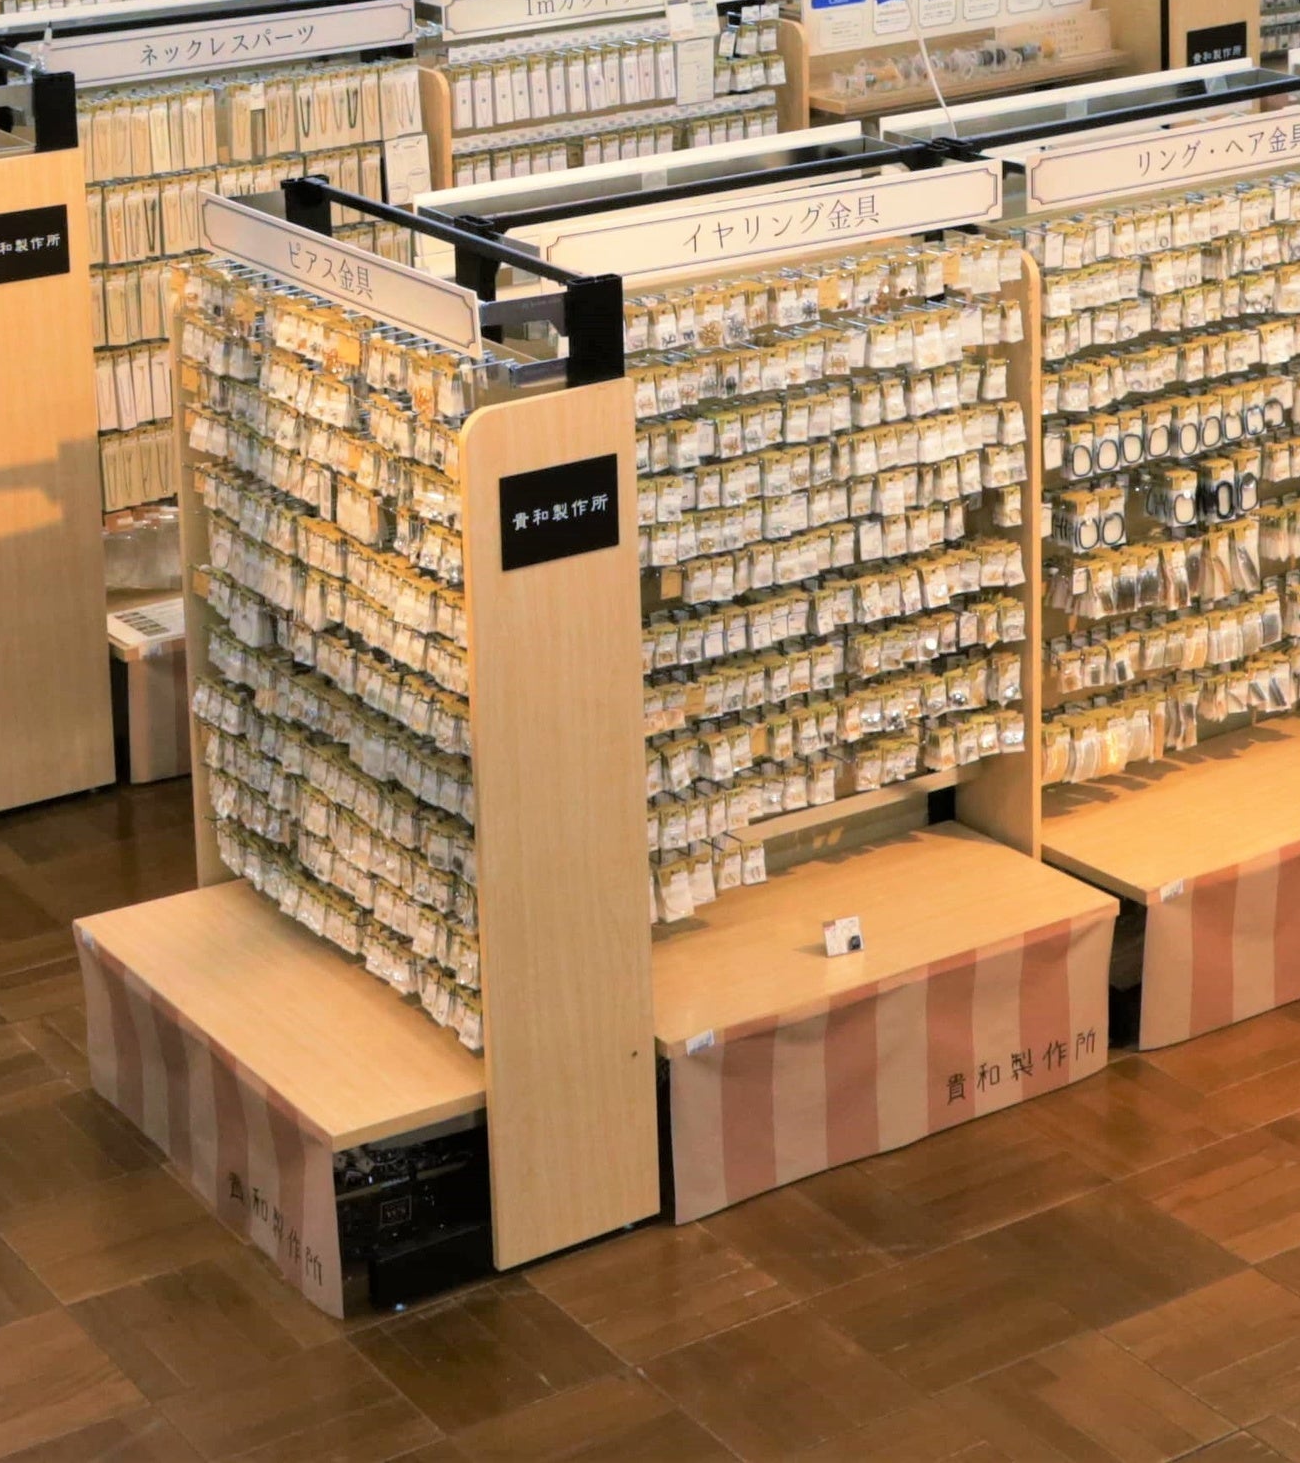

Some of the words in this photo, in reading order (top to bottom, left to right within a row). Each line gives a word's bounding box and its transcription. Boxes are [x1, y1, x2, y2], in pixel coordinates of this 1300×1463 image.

[138, 22, 316, 67] ネックレスパーツ
[681, 193, 881, 255] イヤリング金具
[286, 240, 374, 302] ピアス金具
[511, 492, 609, 533] 貴和製作所
[944, 1027, 1099, 1104] 貴和製作所
